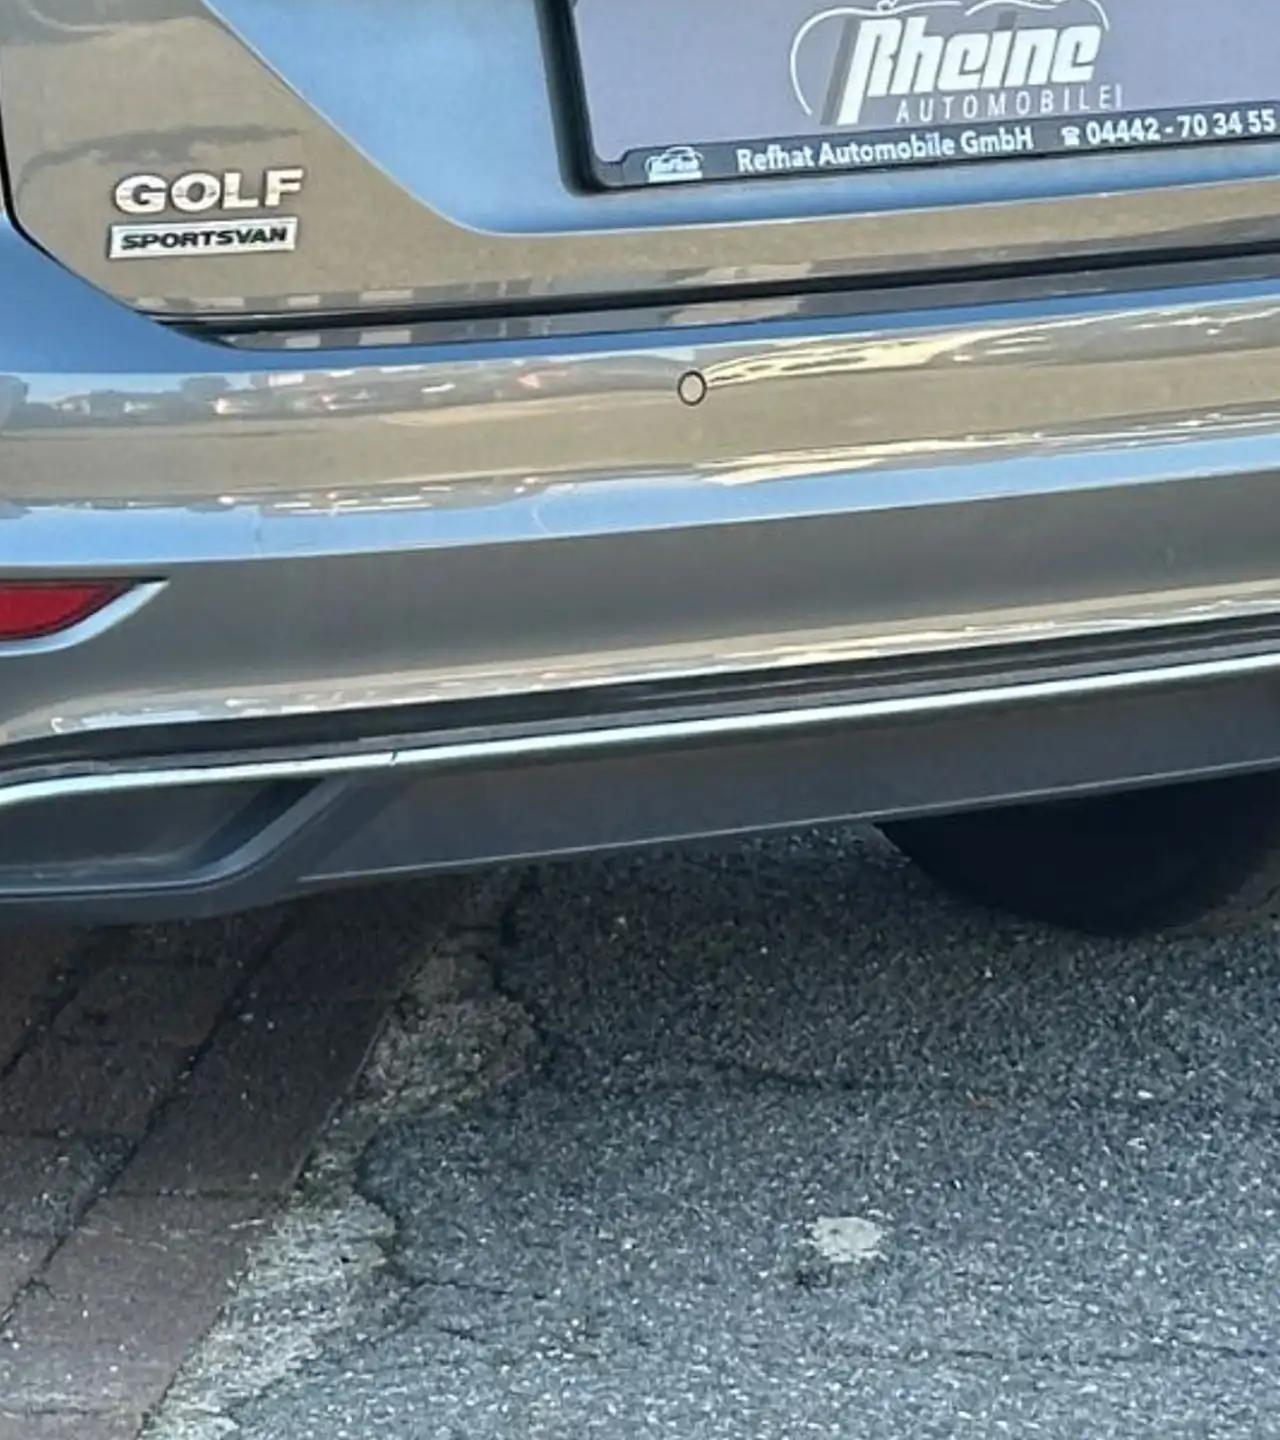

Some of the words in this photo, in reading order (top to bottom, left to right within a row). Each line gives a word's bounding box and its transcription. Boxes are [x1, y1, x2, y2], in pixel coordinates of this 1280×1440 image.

[836, 16, 1102, 126] Rheine
[736, 143, 815, 173] Refhat
[818, 131, 955, 167] Automobile
[960, 125, 1033, 154] GmbH
[1086, 116, 1160, 145] 04442
[1176, 114, 1208, 138] 70
[1212, 110, 1243, 136] 34
[1247, 108, 1276, 133] 55
[114, 167, 304, 214] GOLF
[120, 227, 287, 250] SPORTSVAN
